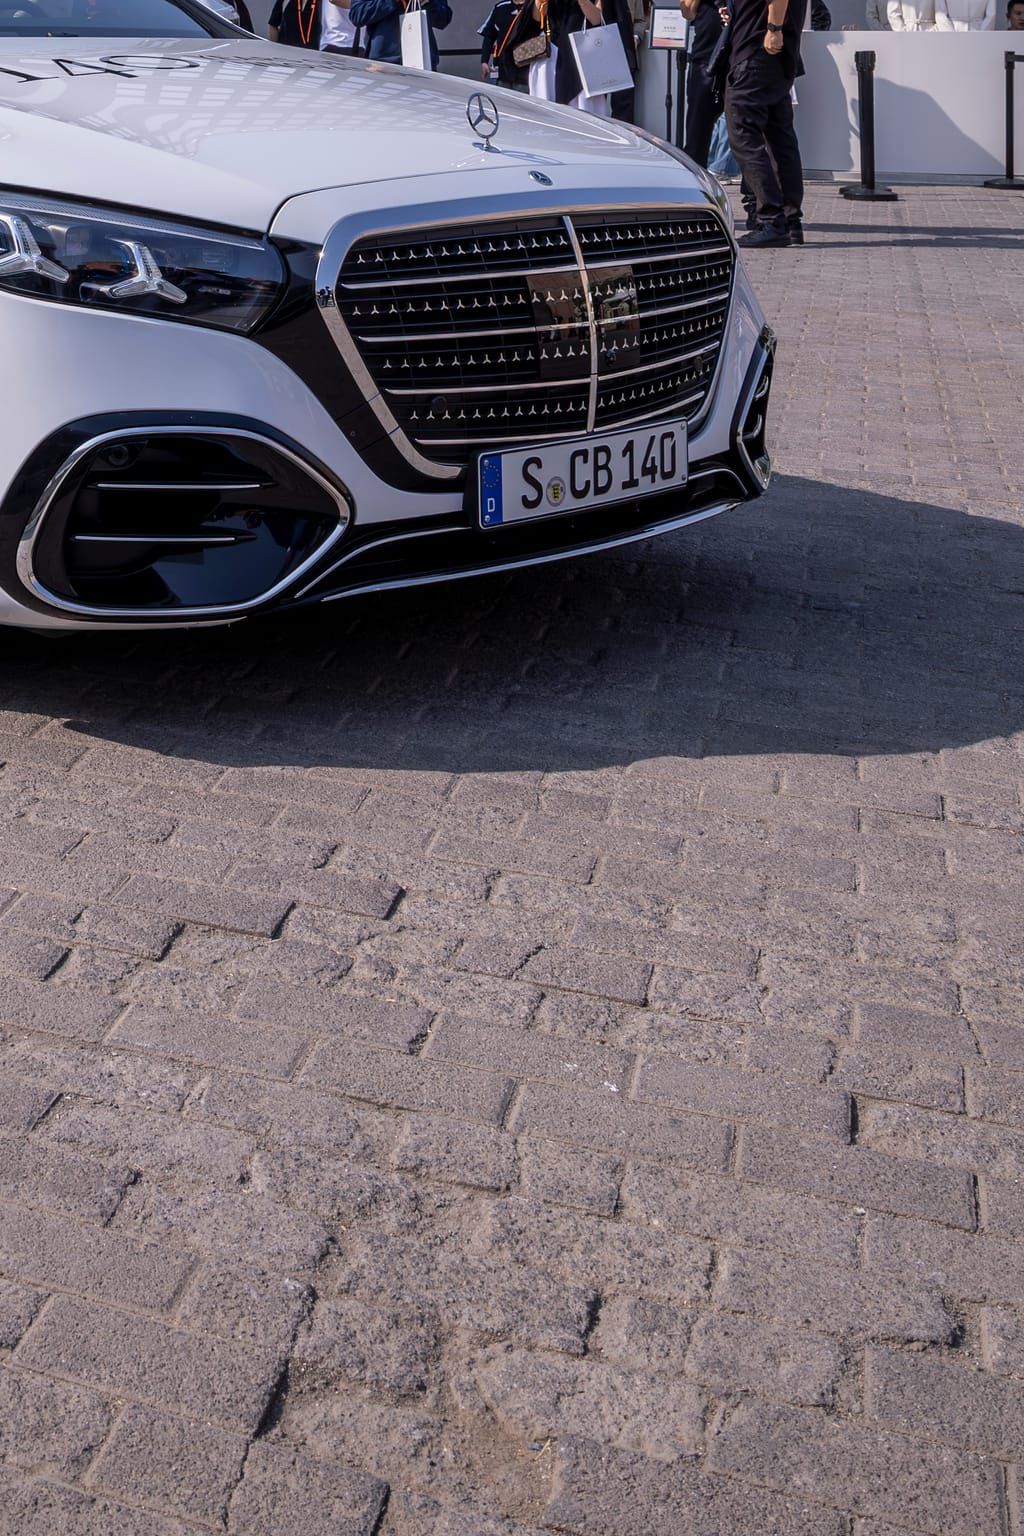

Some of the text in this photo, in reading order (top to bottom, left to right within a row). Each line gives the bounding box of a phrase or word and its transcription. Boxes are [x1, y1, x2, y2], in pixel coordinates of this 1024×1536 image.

[521, 431, 677, 509] S CB 140
[487, 497, 495, 513] D
